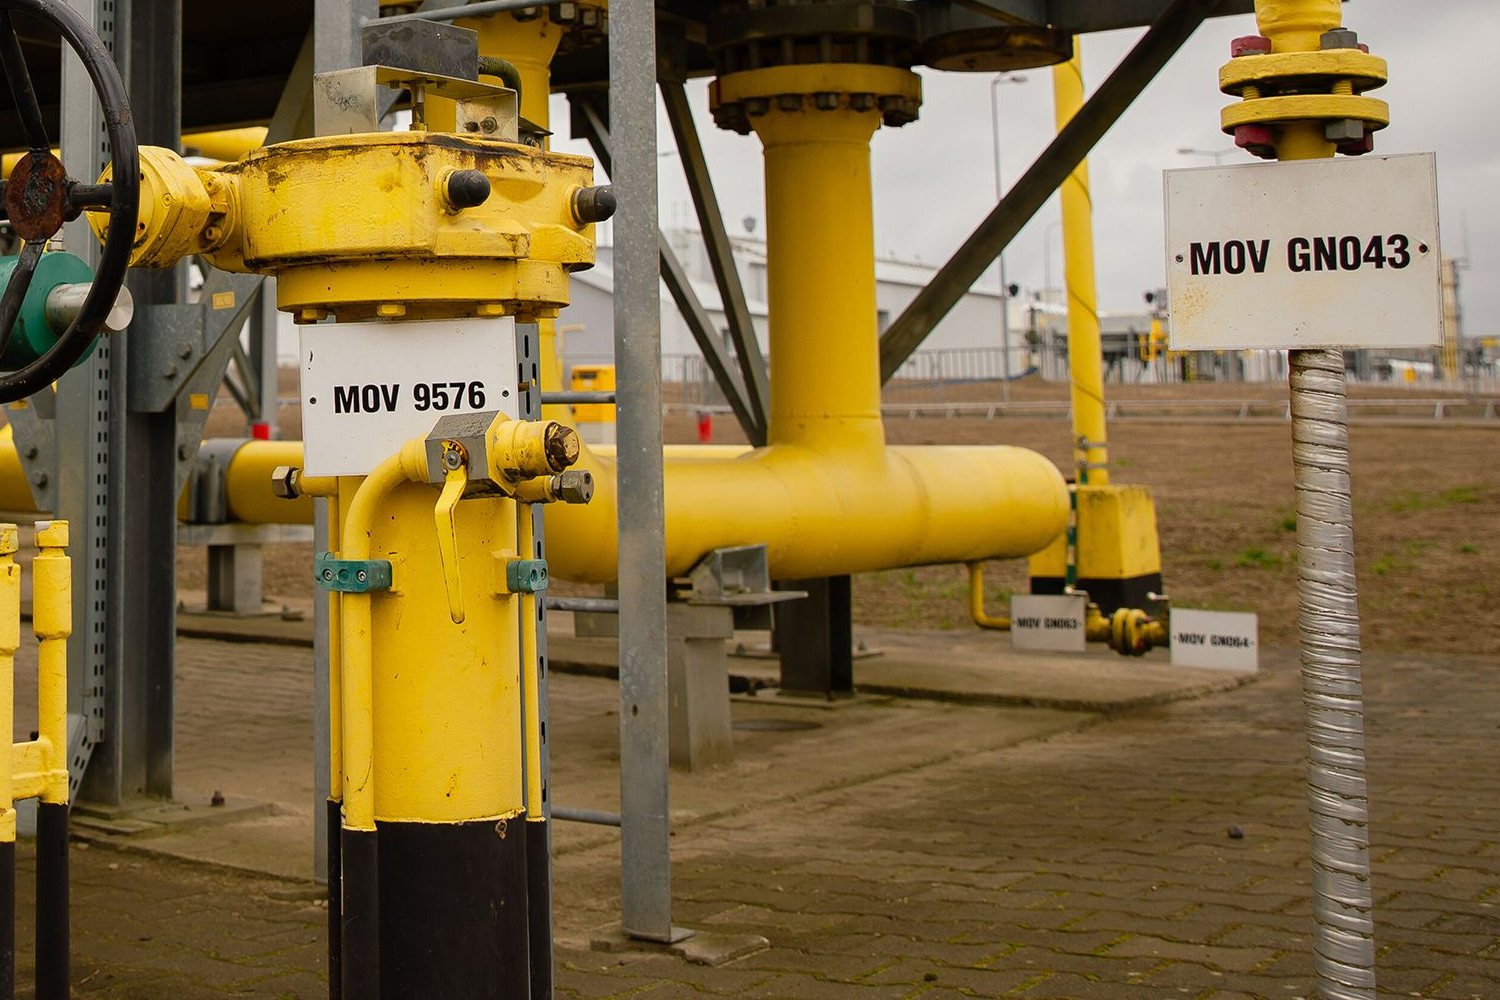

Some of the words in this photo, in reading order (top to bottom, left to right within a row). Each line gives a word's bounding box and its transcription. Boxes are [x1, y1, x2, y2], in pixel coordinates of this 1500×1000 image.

[1190, 239, 1270, 275] MOV
[334, 384, 400, 414] MOV
[413, 381, 485, 411] 9576
[1016, 616, 1040, 629] MOV
[1178, 632, 1205, 645] MOV
